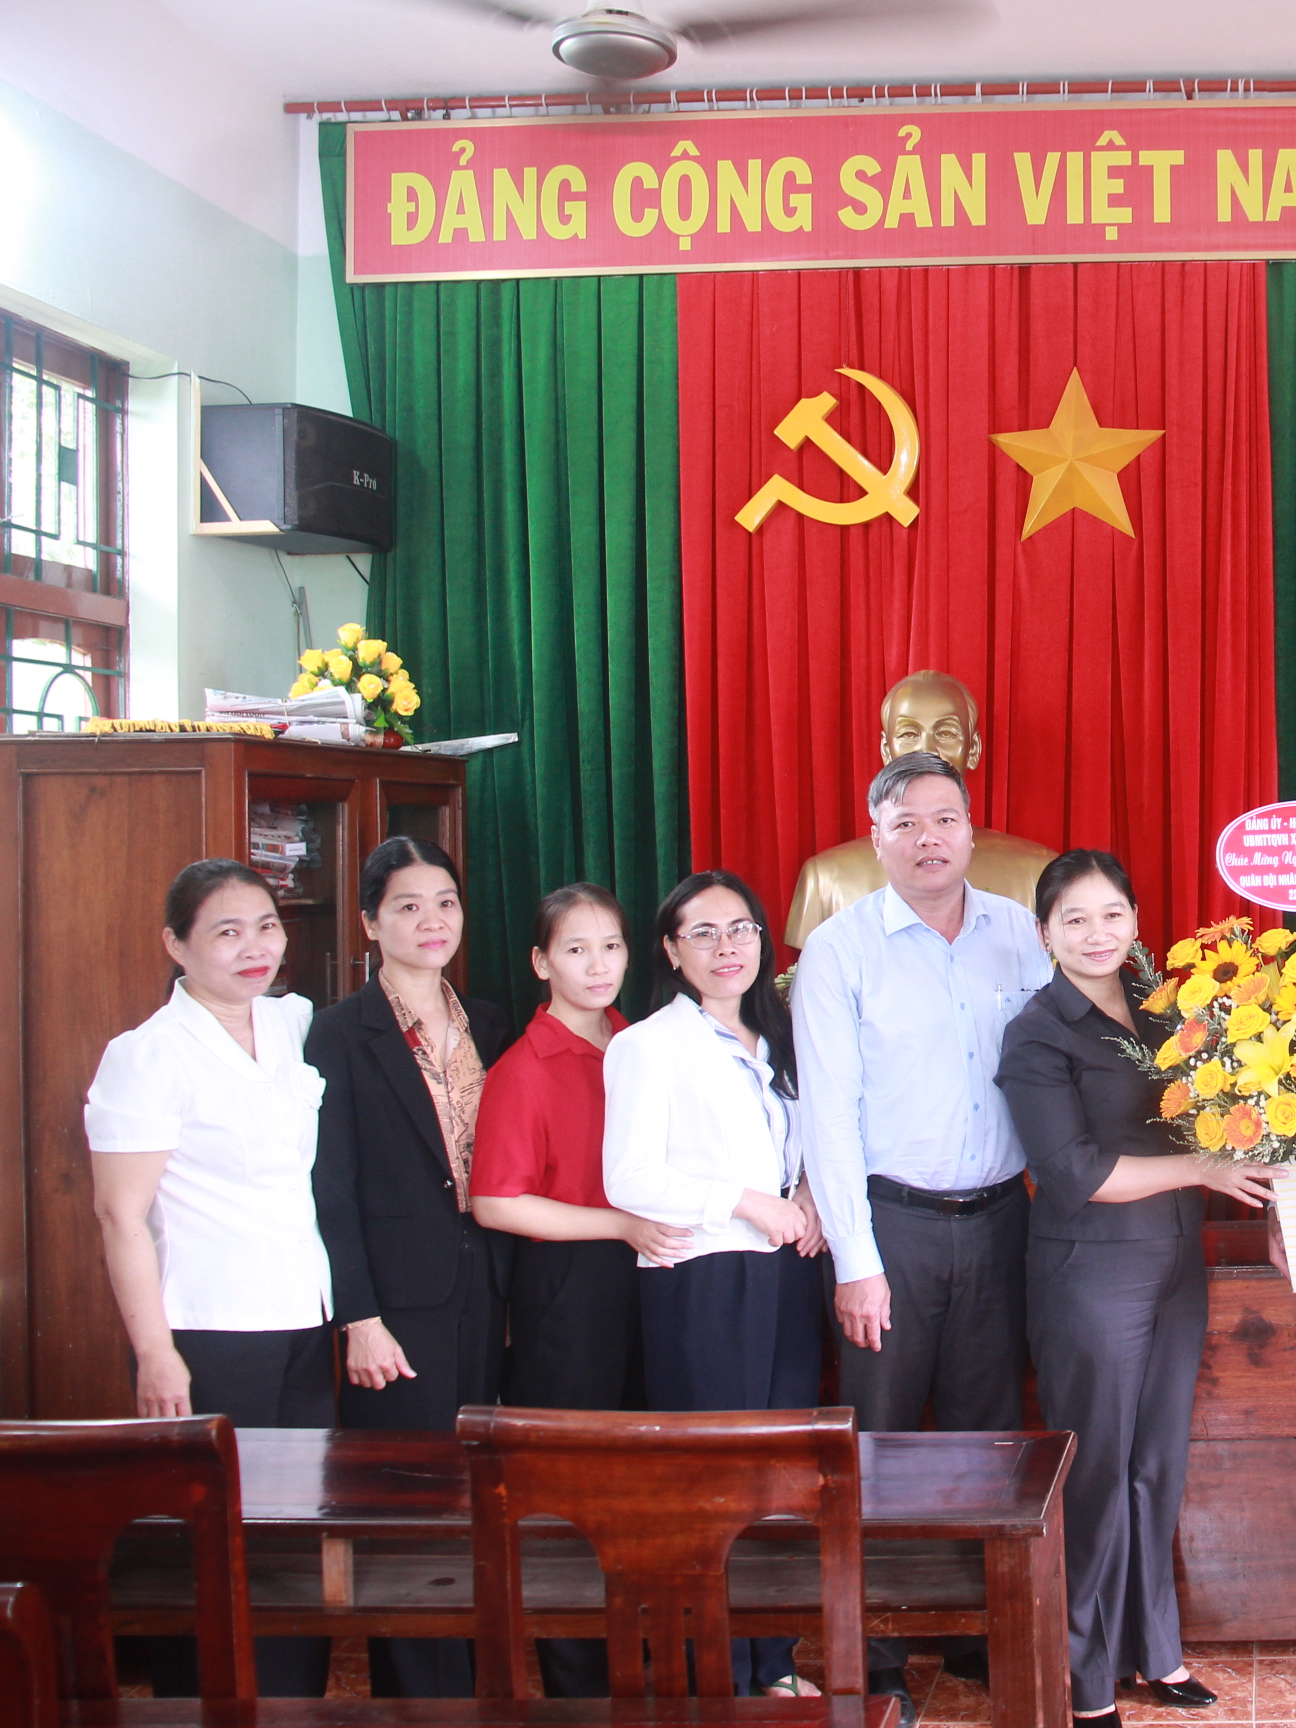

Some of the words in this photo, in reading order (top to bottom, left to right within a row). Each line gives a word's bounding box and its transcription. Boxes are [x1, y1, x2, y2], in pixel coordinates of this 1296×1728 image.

[385, 138, 588, 246] ĐẢNG
[612, 139, 813, 251] CỘNG
[837, 124, 987, 231] SẢN
[1013, 129, 1185, 240] VIỆT
[352, 469, 377, 491] K-Pro
[1245, 815, 1269, 831] ĐẢNG
[1270, 814, 1282, 830] ỦY
[1243, 833, 1289, 847] UBMTTQVN
[1225, 852, 1249, 867] Chúc
[1250, 851, 1279, 868] Mừng
[1240, 873, 1262, 888] QUÂN
[1263, 872, 1277, 888] ĐỘI
